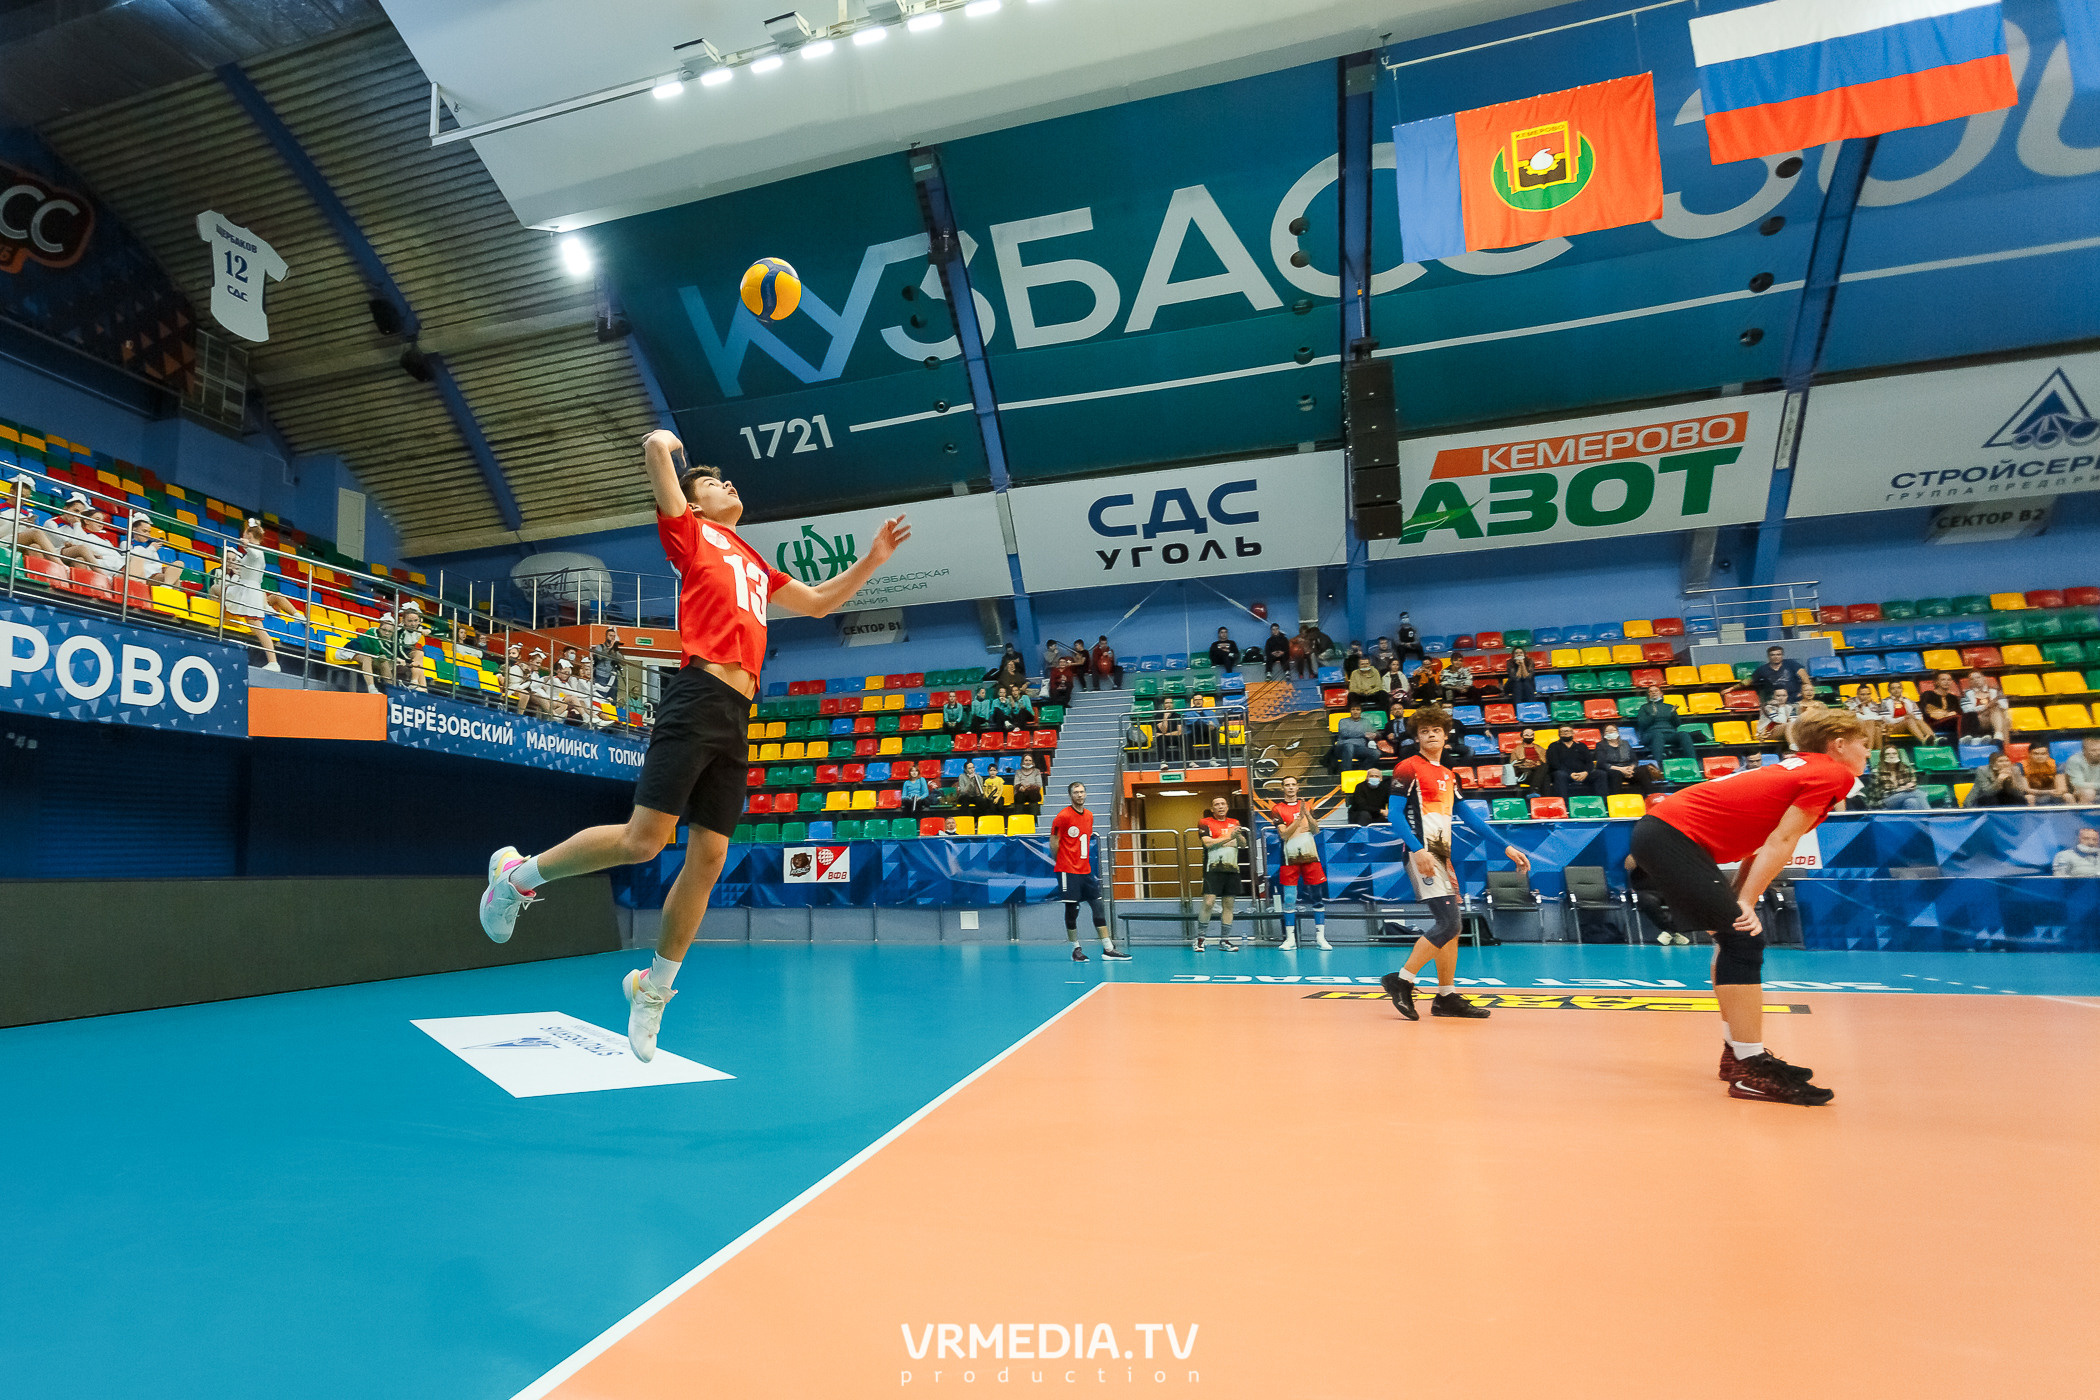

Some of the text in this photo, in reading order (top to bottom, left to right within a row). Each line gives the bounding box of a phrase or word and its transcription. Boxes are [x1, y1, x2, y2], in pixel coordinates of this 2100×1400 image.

[224, 250, 249, 283] 12
[739, 413, 834, 461] 1721
[1482, 416, 1736, 473] КЕМЕРОВО
[1088, 478, 1260, 540] СДС
[1397, 446, 1743, 545] АЗОТ
[1886, 485, 1974, 502] ГРУППА
[1936, 506, 2047, 530] СЕКТОР В2
[1095, 536, 1263, 571] УГОЛЬ
[722, 553, 769, 628] 13
[843, 623, 885, 636] СЕКТОР
[0, 619, 220, 715] РОВО
[390, 703, 514, 746] БЕРЁЗОВСКИЙ
[526, 730, 599, 760] МАРИИНСК
[1079, 833, 1089, 860] 1
